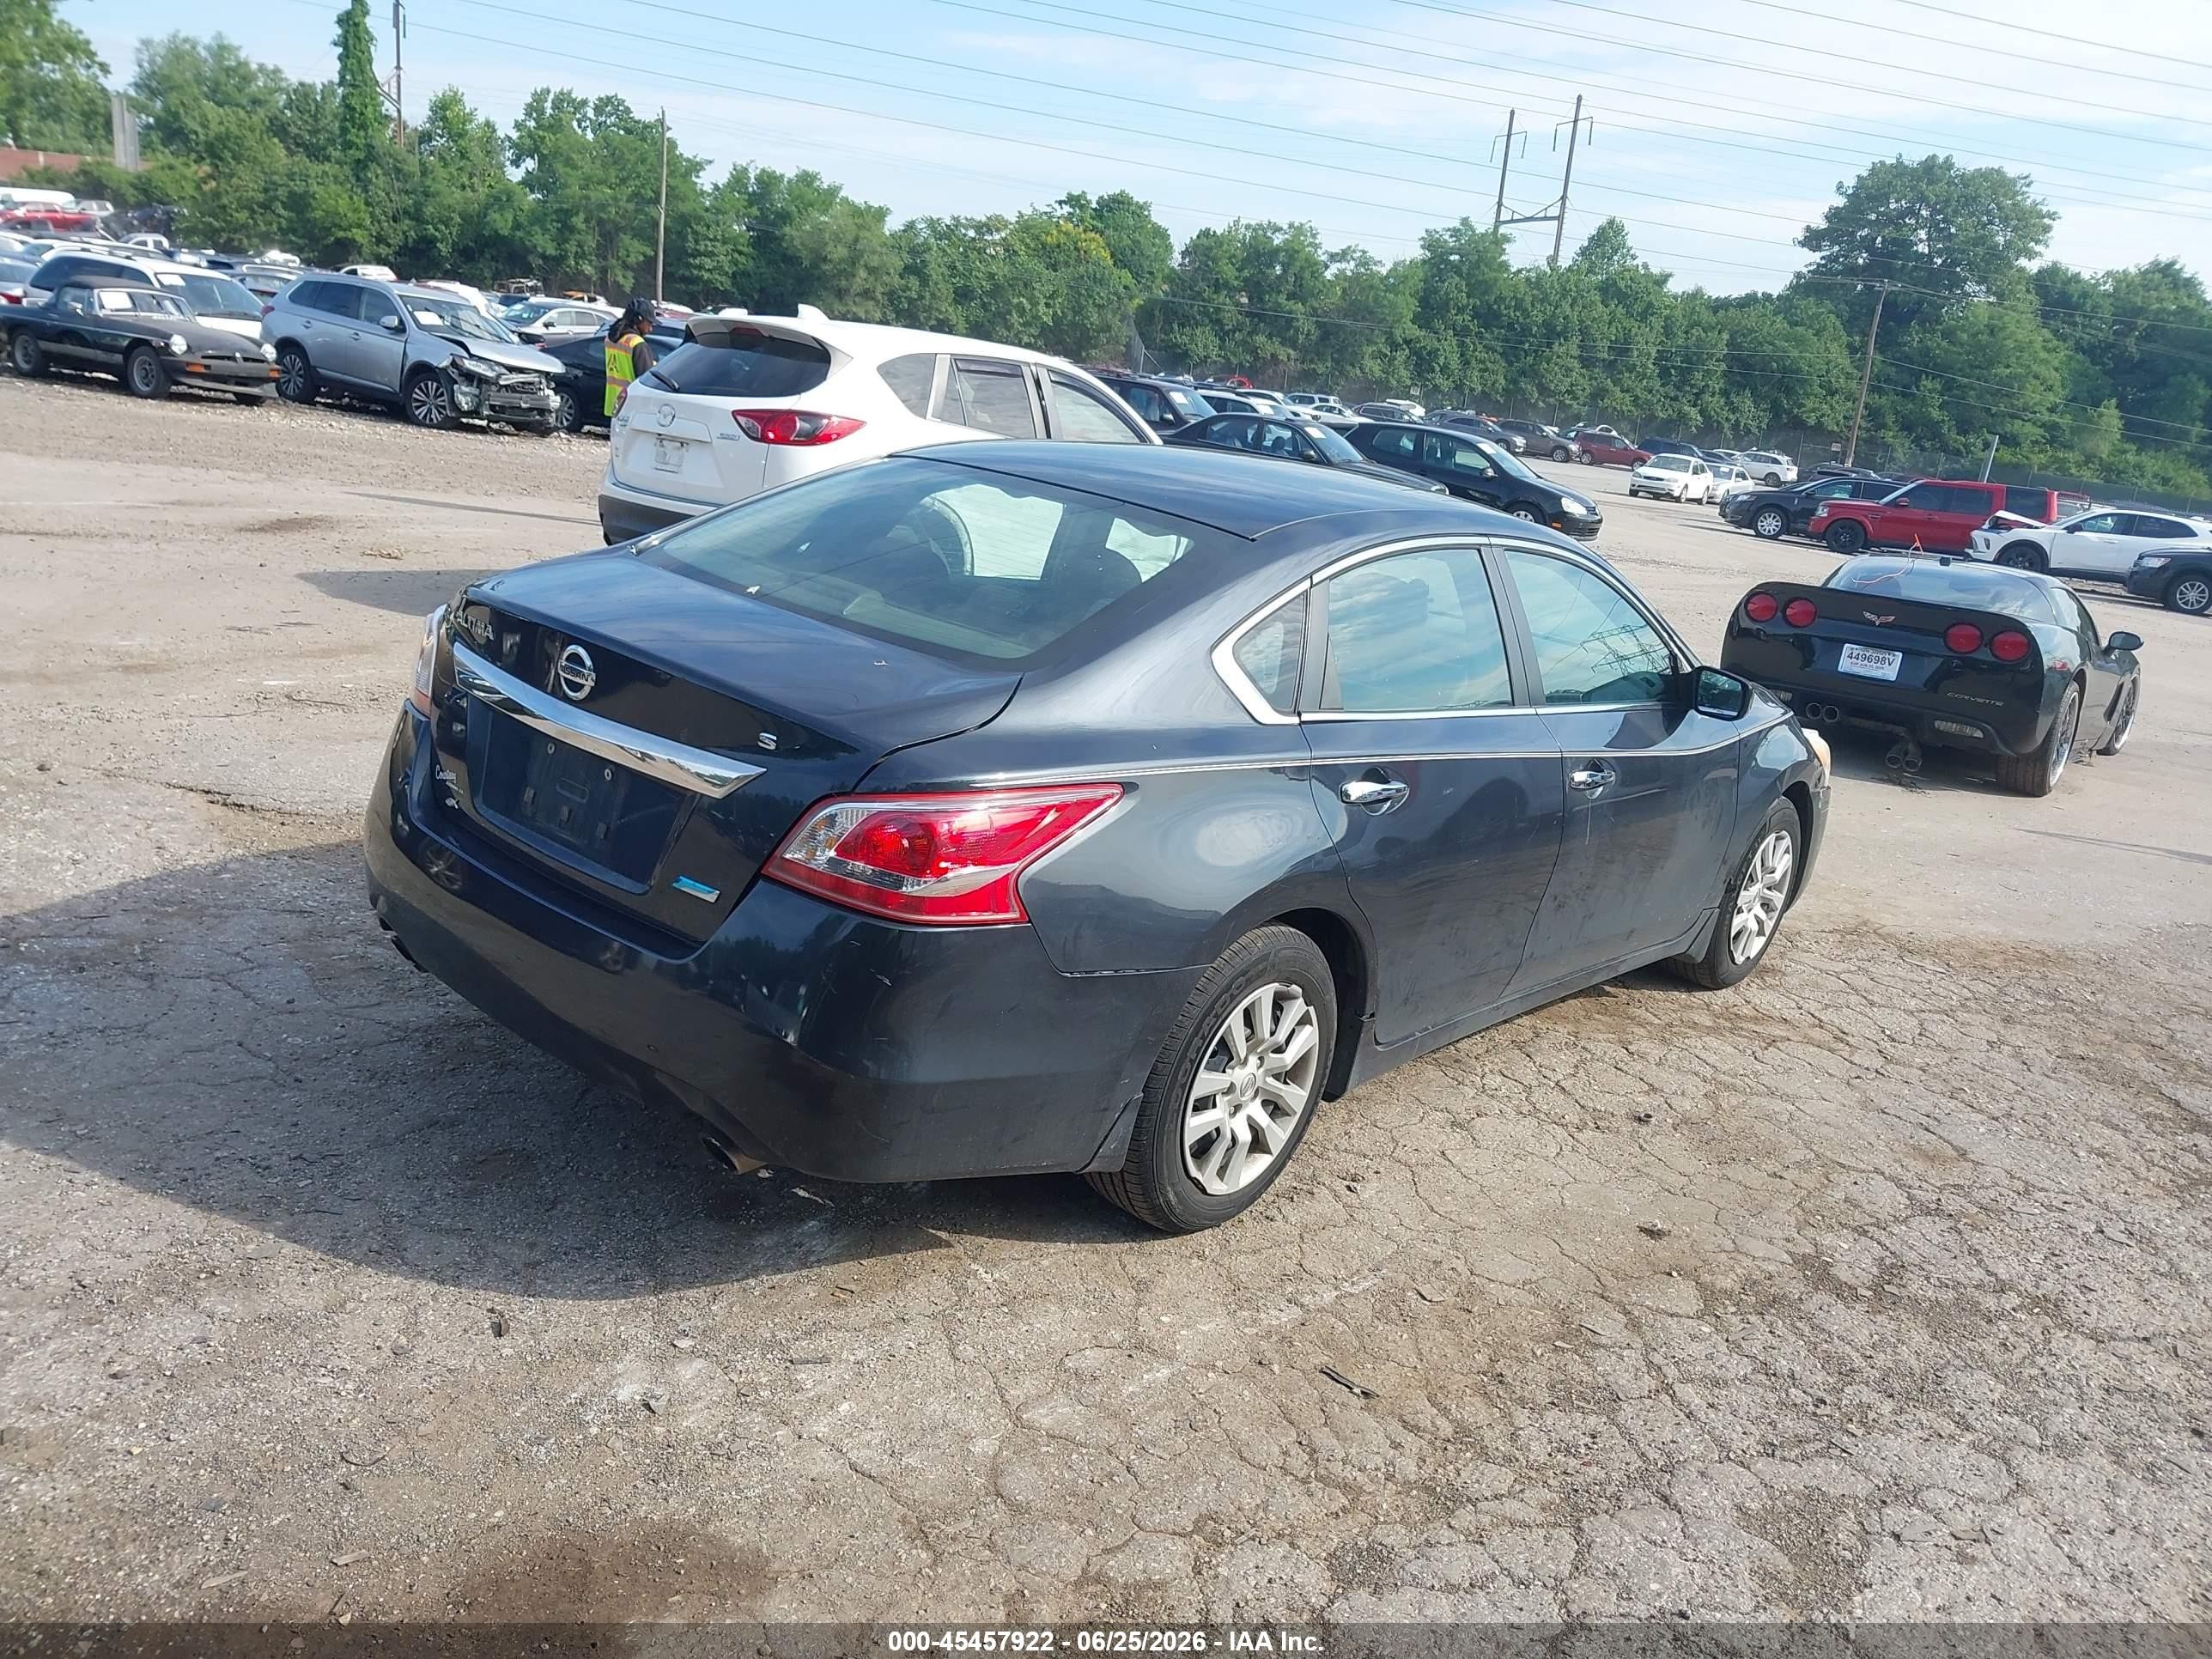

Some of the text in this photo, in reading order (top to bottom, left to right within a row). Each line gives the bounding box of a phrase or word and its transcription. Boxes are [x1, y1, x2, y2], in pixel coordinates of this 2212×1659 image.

[456, 611, 494, 641] ALTIMA
[1847, 652, 1896, 667] 449698V
[757, 732, 777, 750] S
